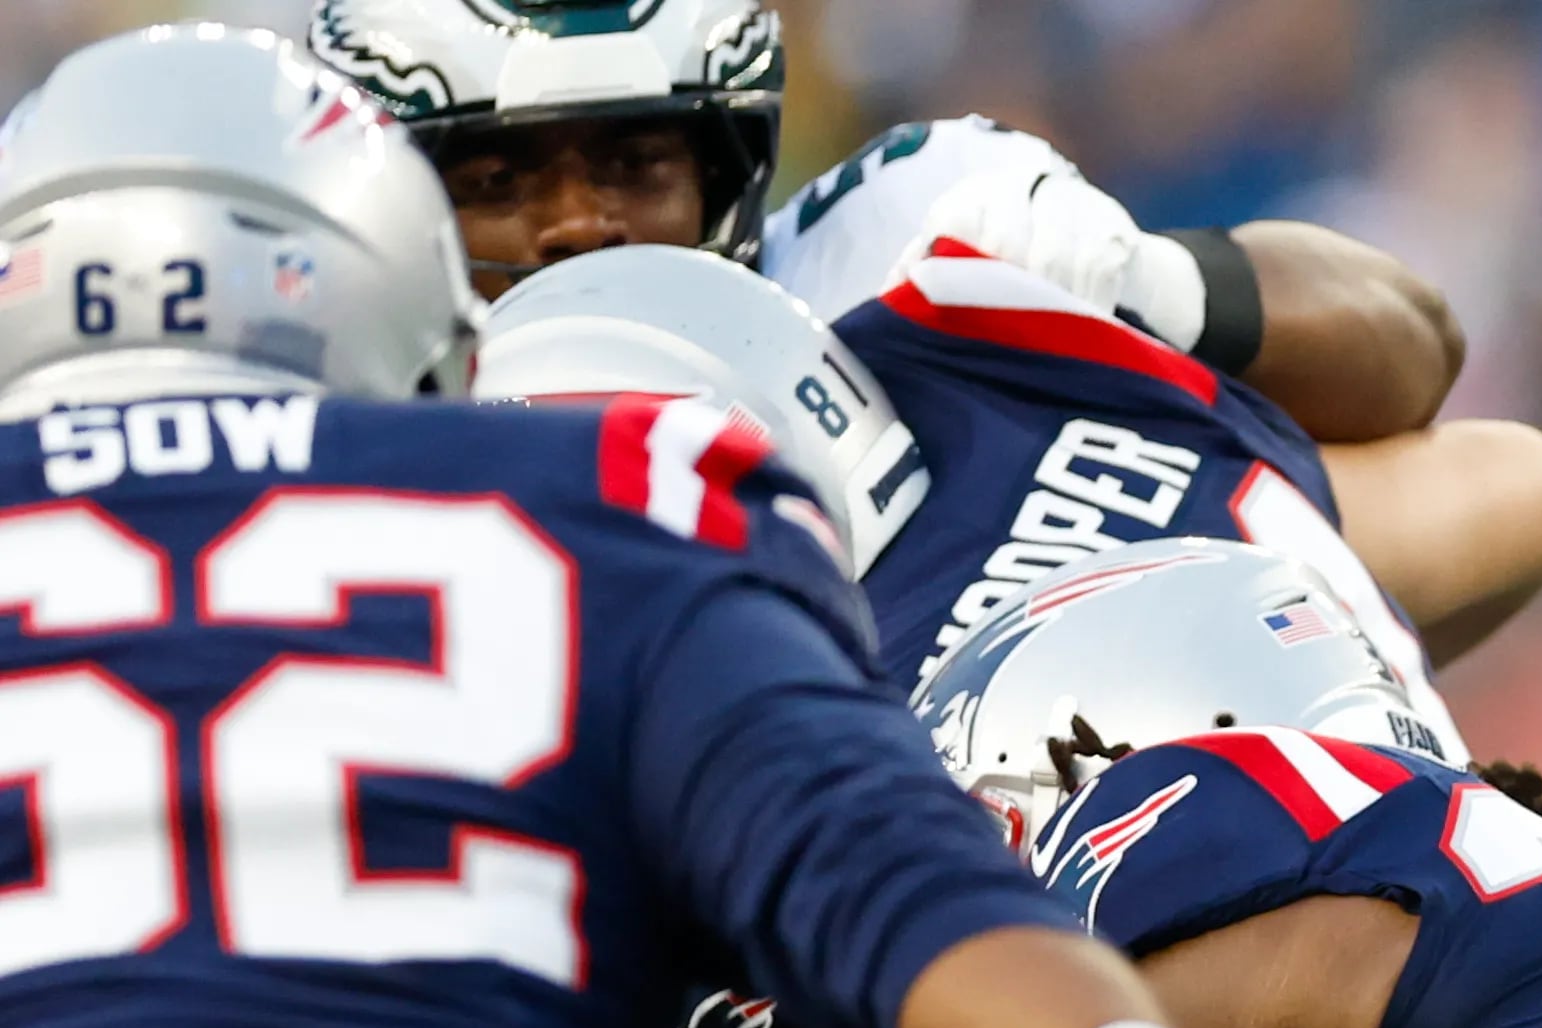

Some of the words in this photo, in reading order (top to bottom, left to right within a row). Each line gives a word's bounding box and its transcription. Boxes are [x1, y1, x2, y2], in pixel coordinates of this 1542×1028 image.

[38, 394, 321, 495] SOW
[795, 352, 869, 439] 81
[917, 418, 1202, 680] OPER
